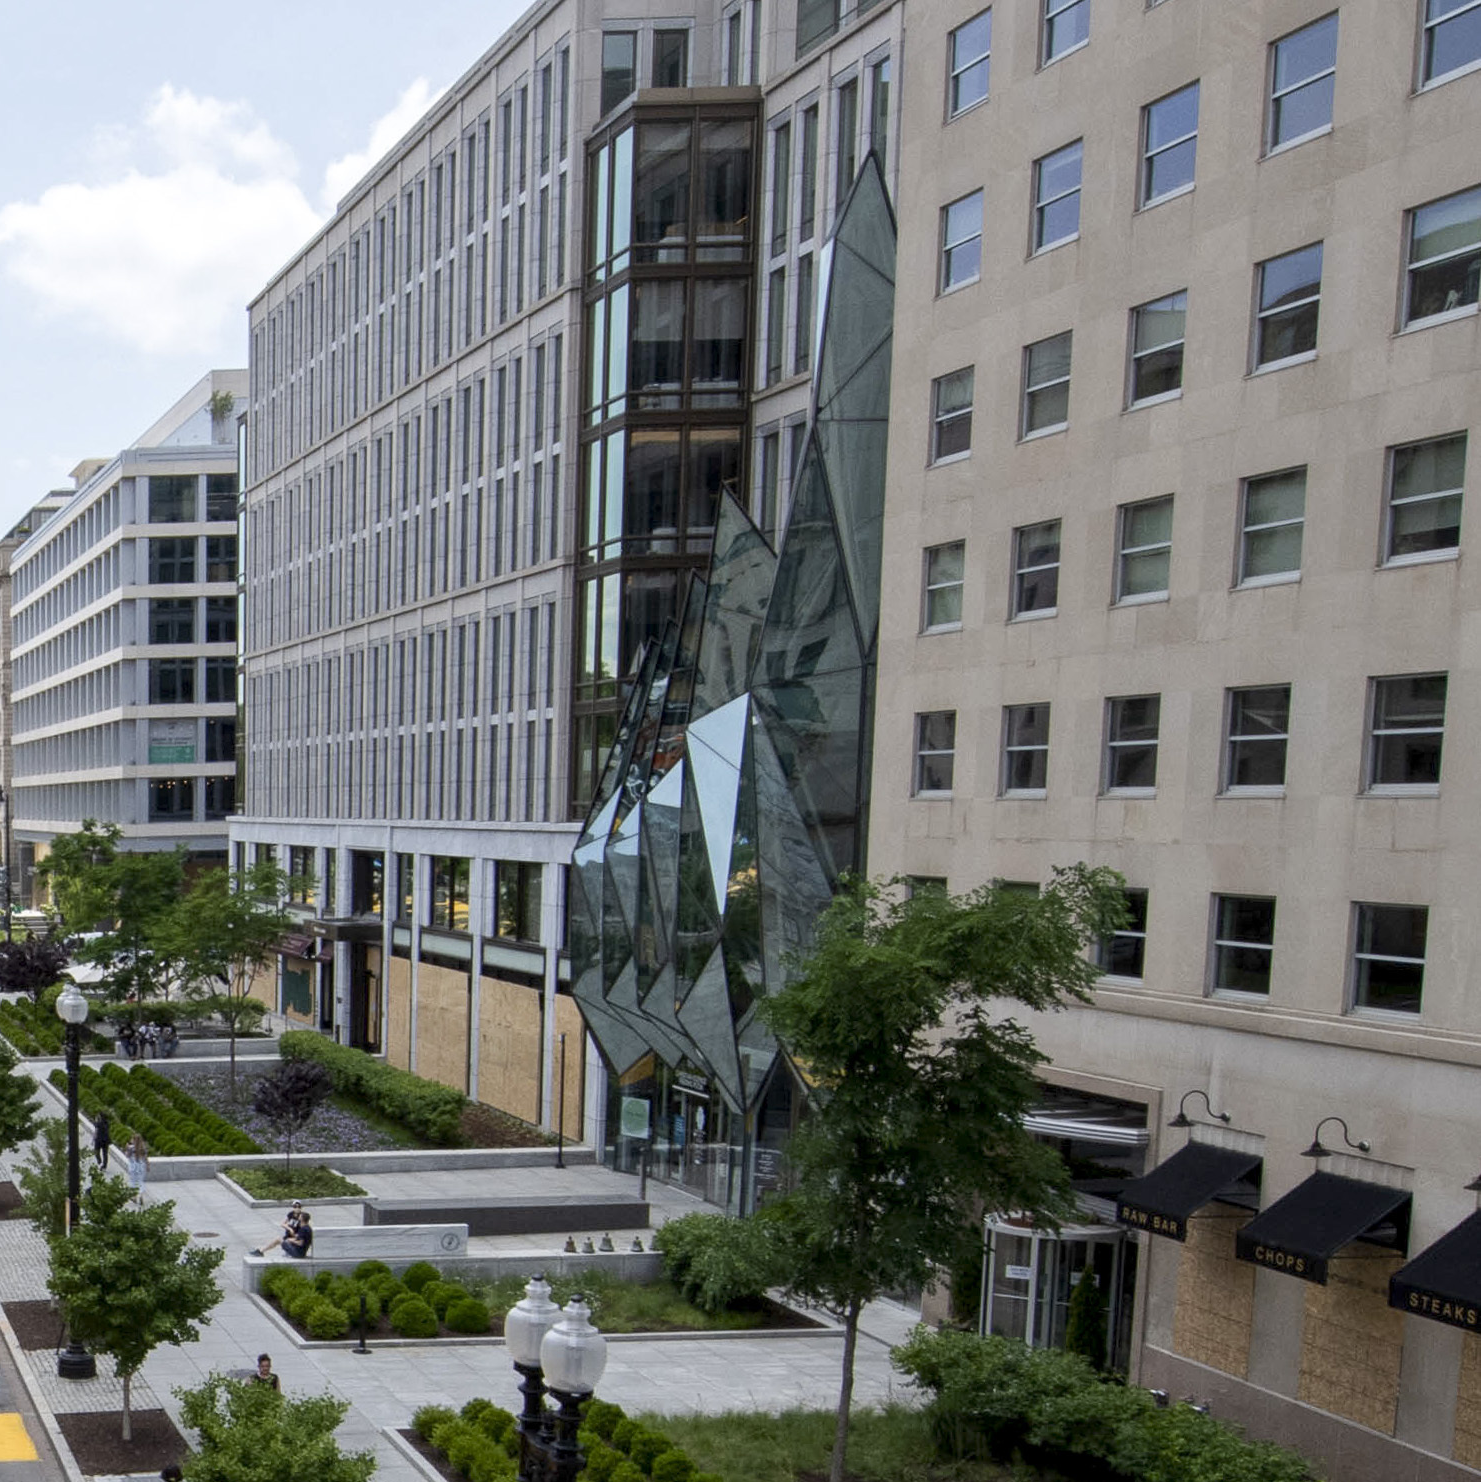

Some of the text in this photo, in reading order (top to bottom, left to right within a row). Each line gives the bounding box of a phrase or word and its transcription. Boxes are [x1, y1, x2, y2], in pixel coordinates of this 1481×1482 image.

[1122, 1206, 1179, 1235] RAW BAR
[1254, 1246, 1306, 1273] CHOPS
[1409, 1292, 1477, 1325] STEAKS
